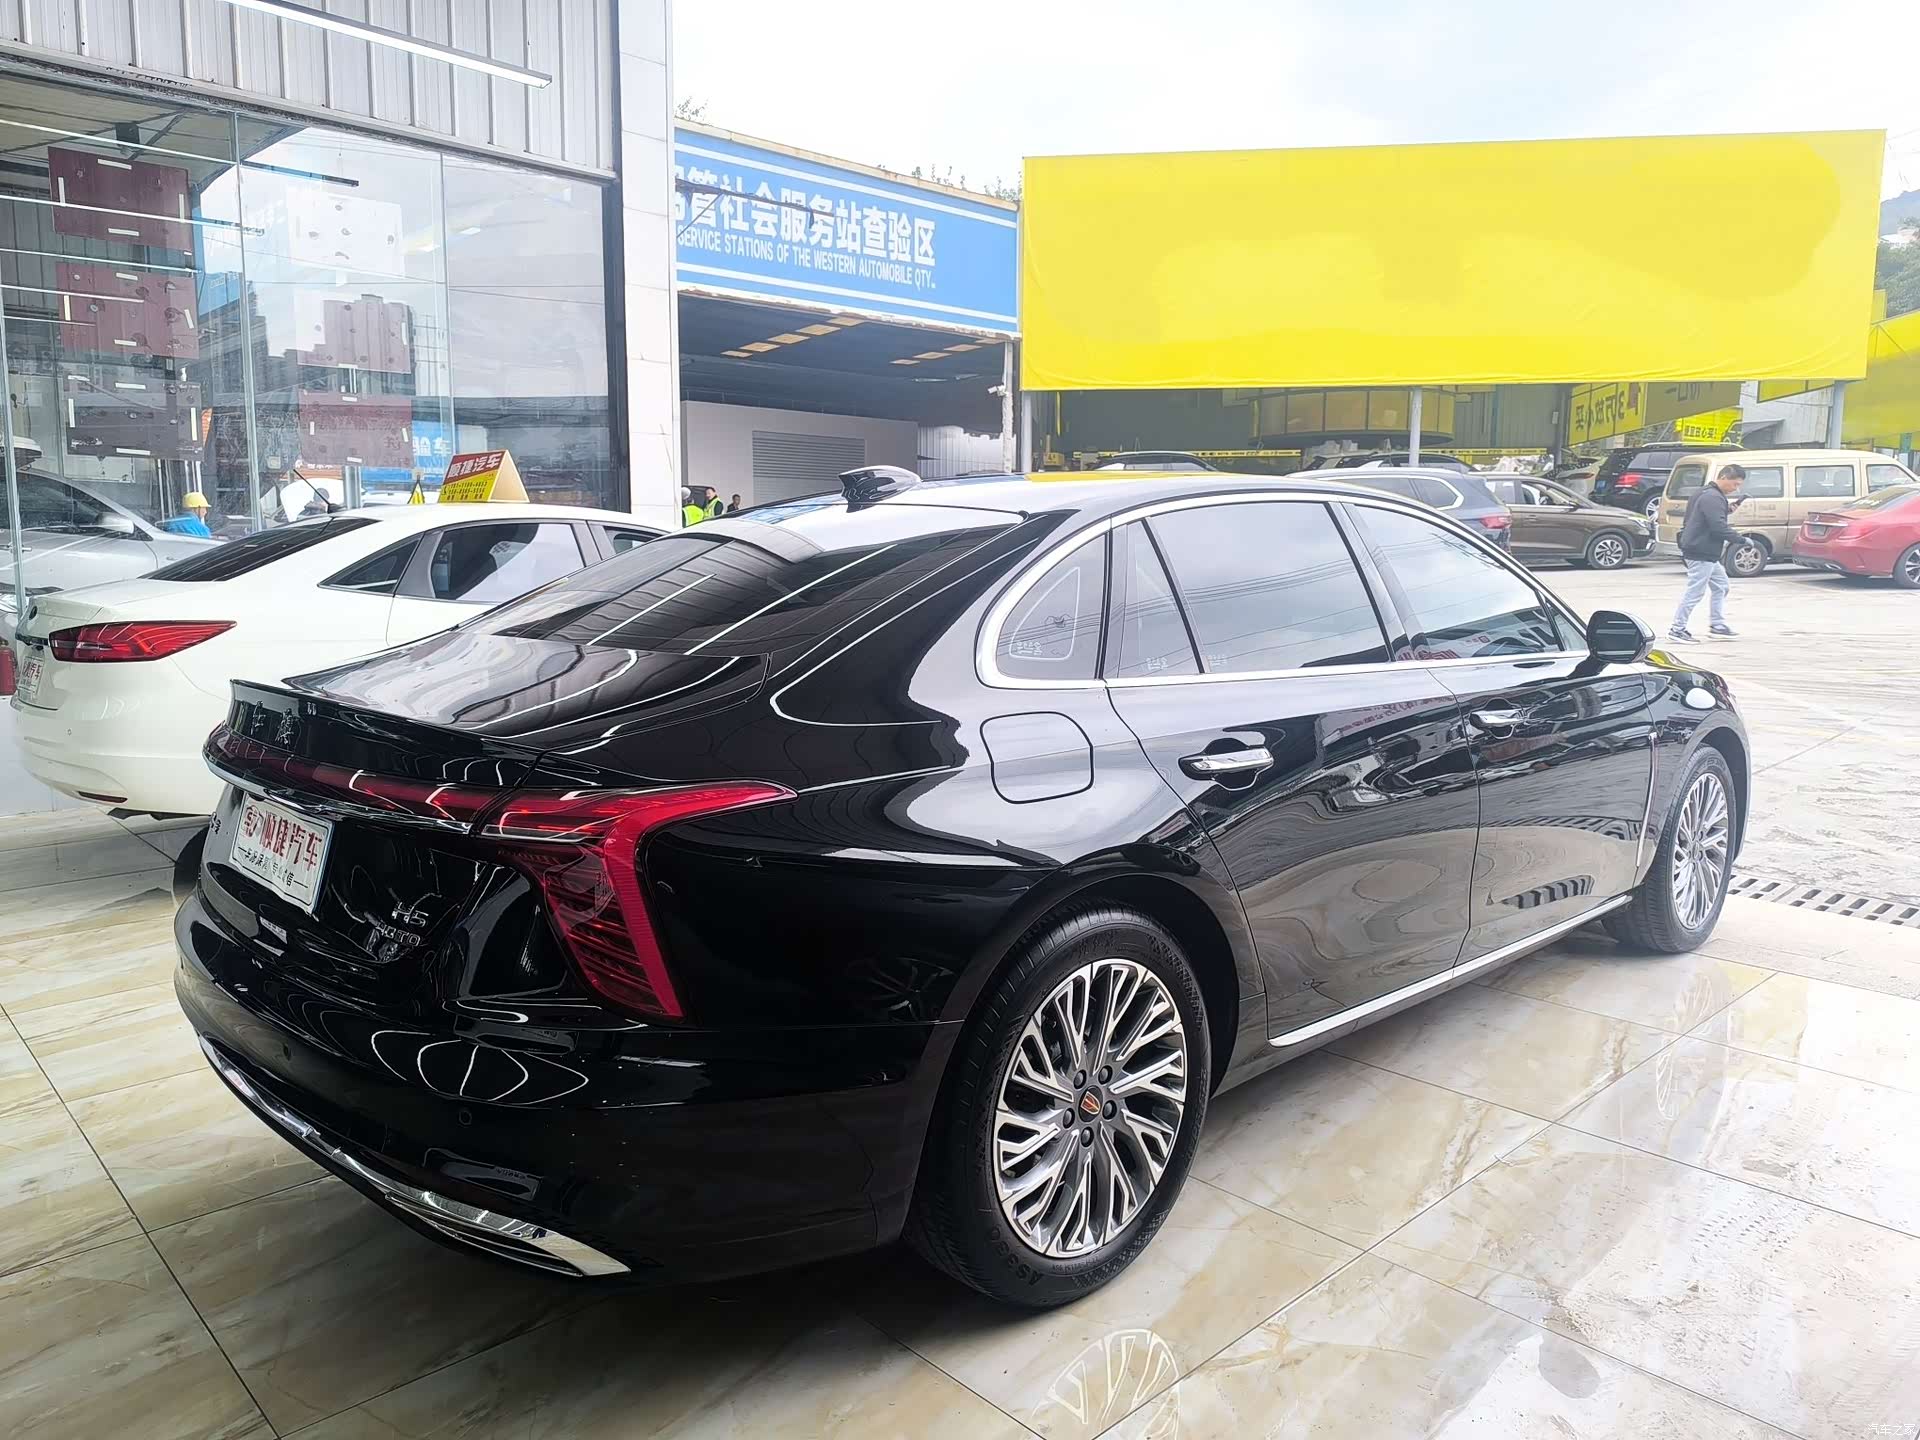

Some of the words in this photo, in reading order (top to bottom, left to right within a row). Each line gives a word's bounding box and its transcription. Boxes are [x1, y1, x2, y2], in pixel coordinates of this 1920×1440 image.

[678, 224, 721, 253] SERVICE
[724, 234, 774, 262] STATIONS
[776, 243, 790, 264] OF
[793, 246, 811, 269] THE
[814, 251, 857, 275] WESTERN
[859, 259, 913, 285] AUTOMOBILE
